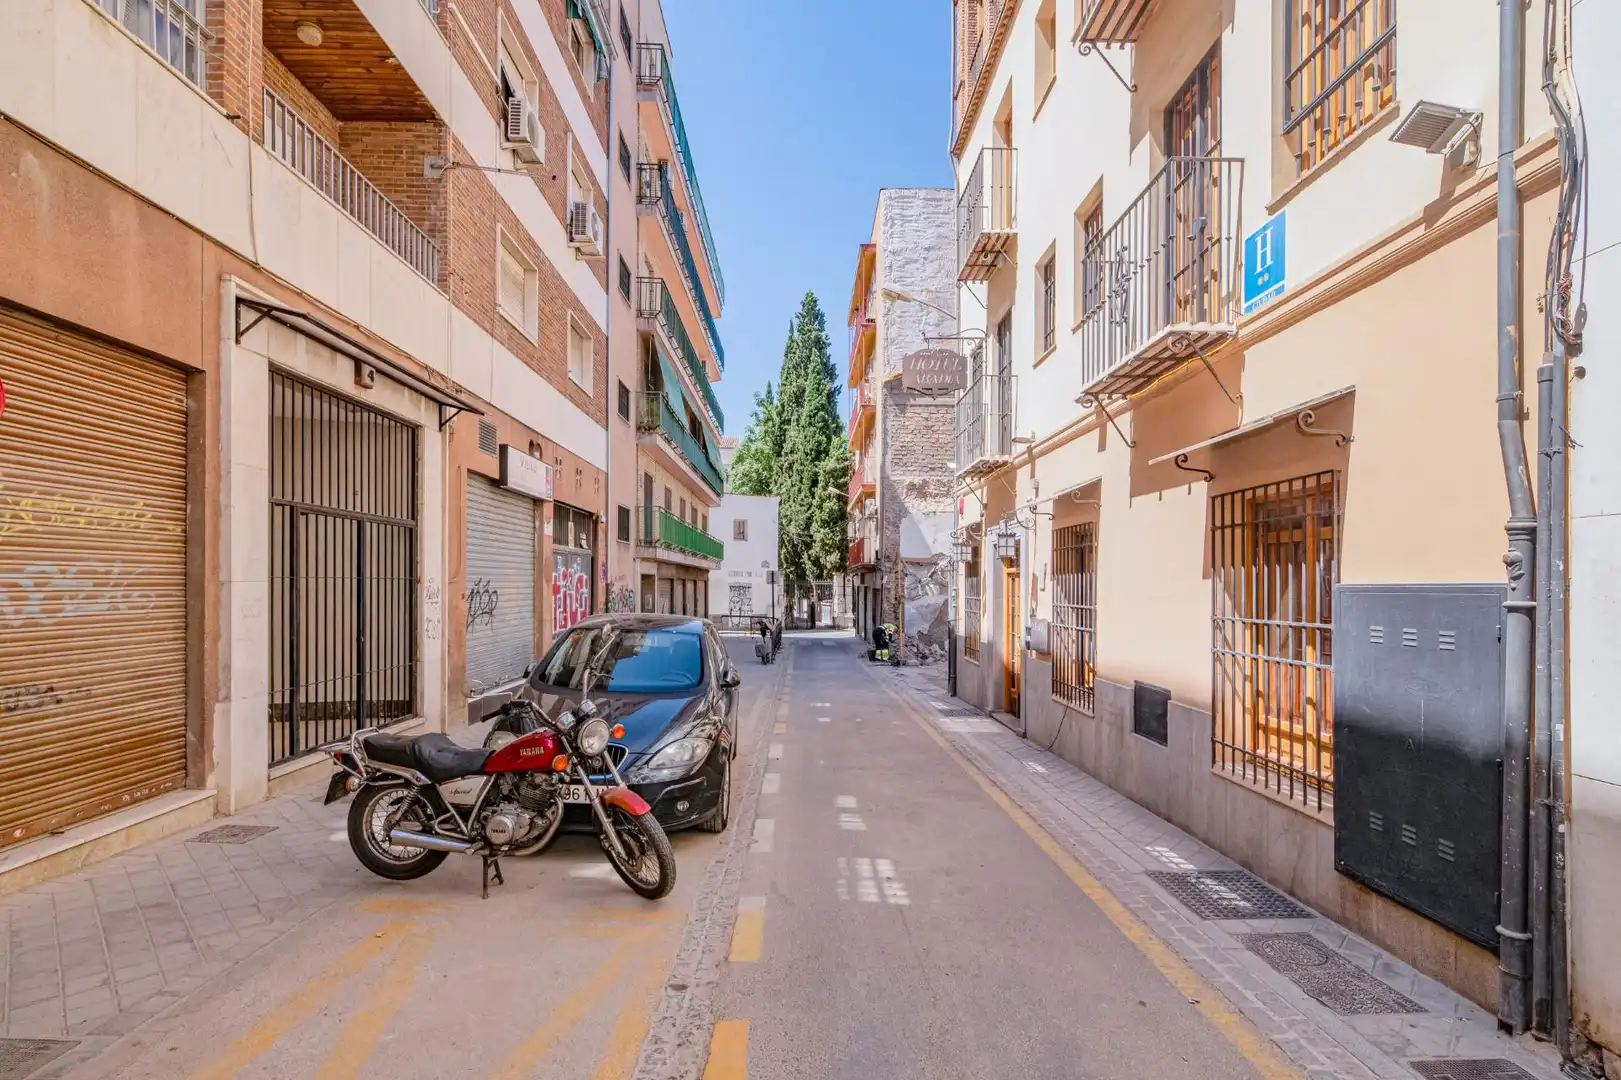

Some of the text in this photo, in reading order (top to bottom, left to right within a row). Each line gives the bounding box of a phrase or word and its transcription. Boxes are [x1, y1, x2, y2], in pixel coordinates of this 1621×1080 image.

[1254, 226, 1274, 275] H
[909, 357, 962, 371] HOTEL
[367, 370, 375, 382] 4
[519, 746, 544, 757] YAMAHA
